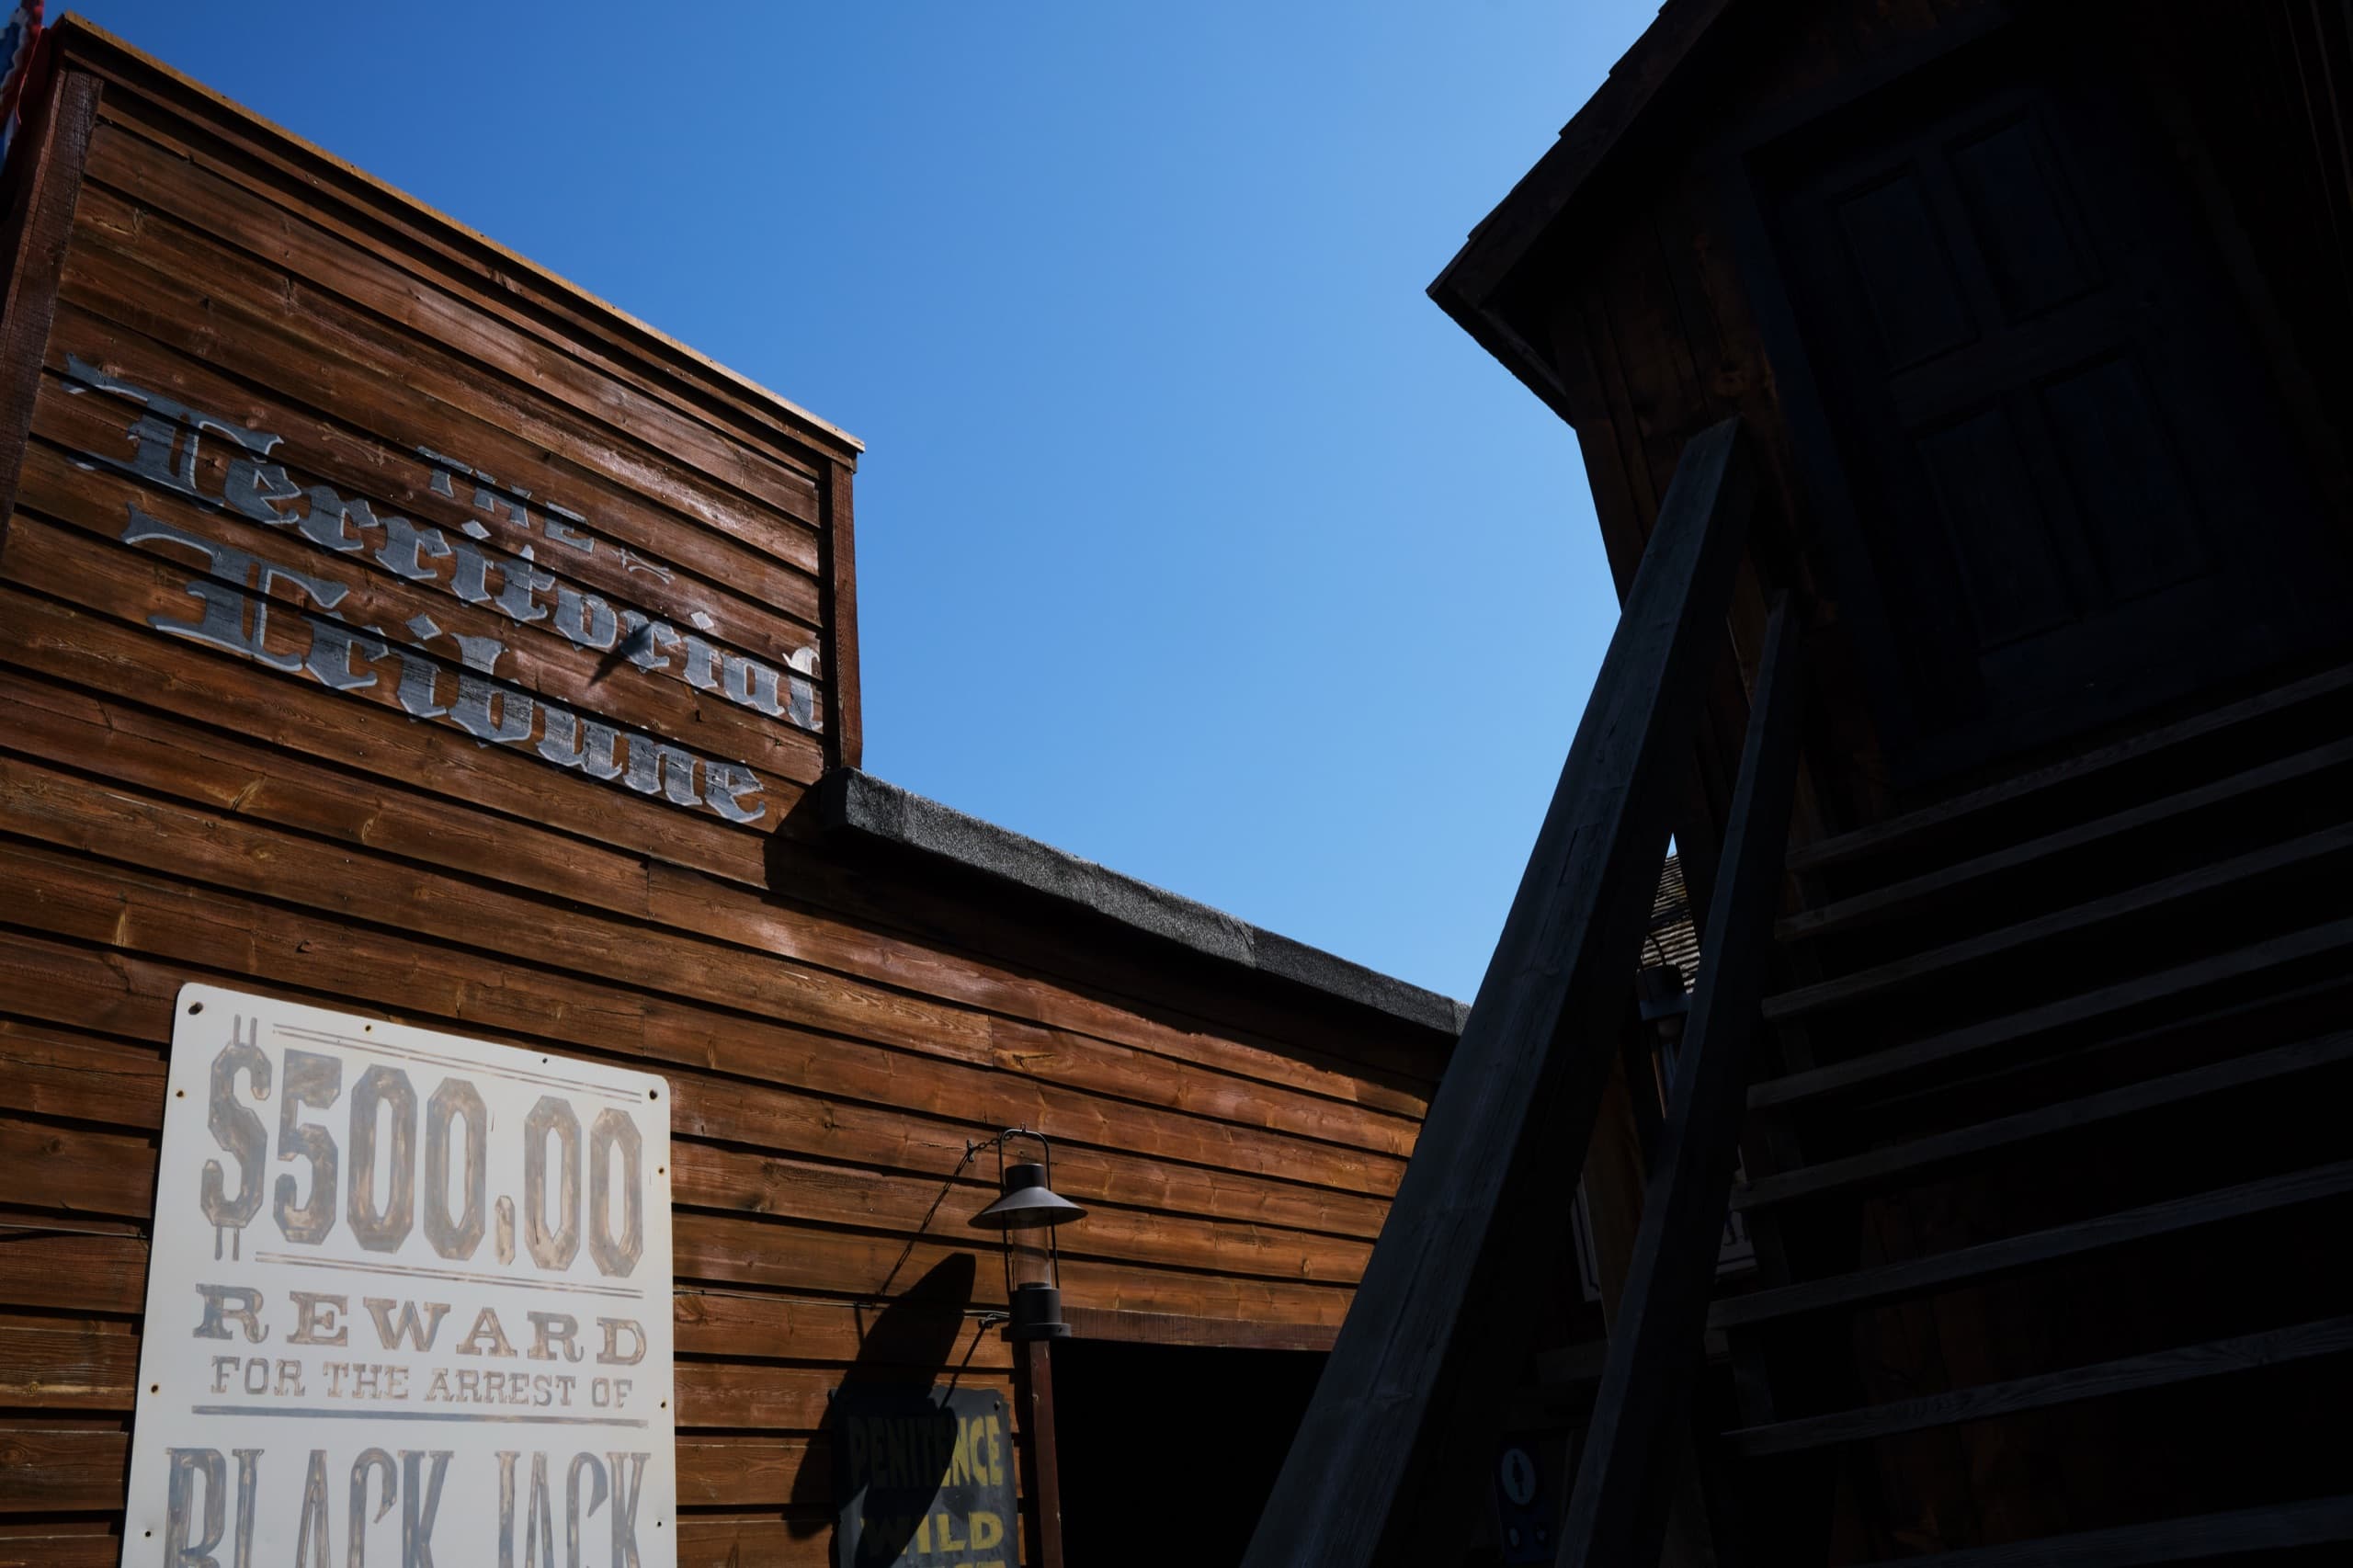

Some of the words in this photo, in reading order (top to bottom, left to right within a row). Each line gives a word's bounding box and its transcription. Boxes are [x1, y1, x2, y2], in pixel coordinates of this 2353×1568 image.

[62, 352, 824, 732] Territorial
[416, 445, 596, 554] THE
[120, 501, 767, 824] Tribune
[199, 1013, 644, 1278] $500.00
[192, 1282, 647, 1367] REWARD
[210, 1355, 306, 1397] FOR
[323, 1361, 410, 1401] THE
[423, 1367, 577, 1407] ARREST
[591, 1375, 634, 1409] OF
[847, 1415, 1005, 1488] PENITENCE
[858, 1510, 1006, 1556] WILD
